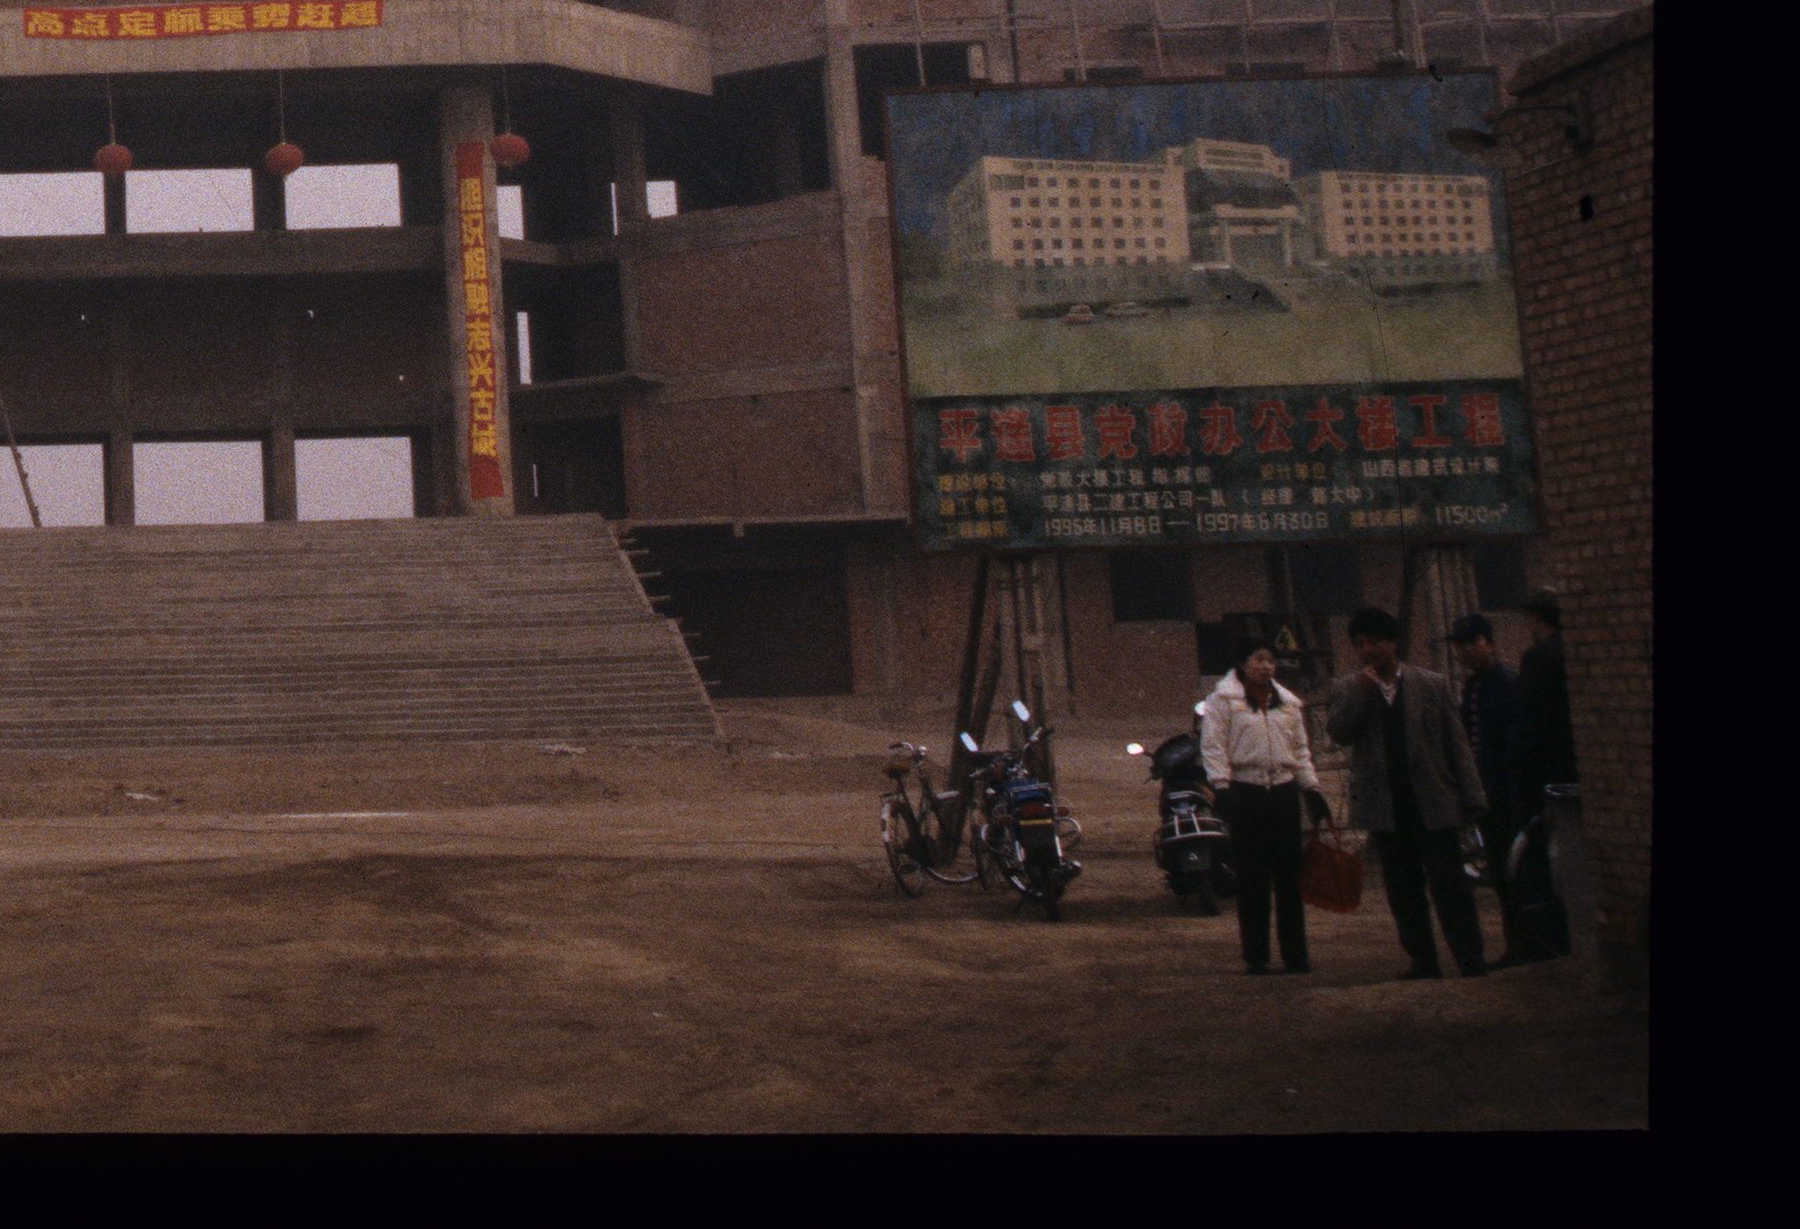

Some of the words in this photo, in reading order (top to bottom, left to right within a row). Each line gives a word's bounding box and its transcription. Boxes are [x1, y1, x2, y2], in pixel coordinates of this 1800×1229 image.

[28, 1, 378, 38] 高点定标乘势赶超
[939, 394, 1505, 463] 平遥县党政办公大楼工程
